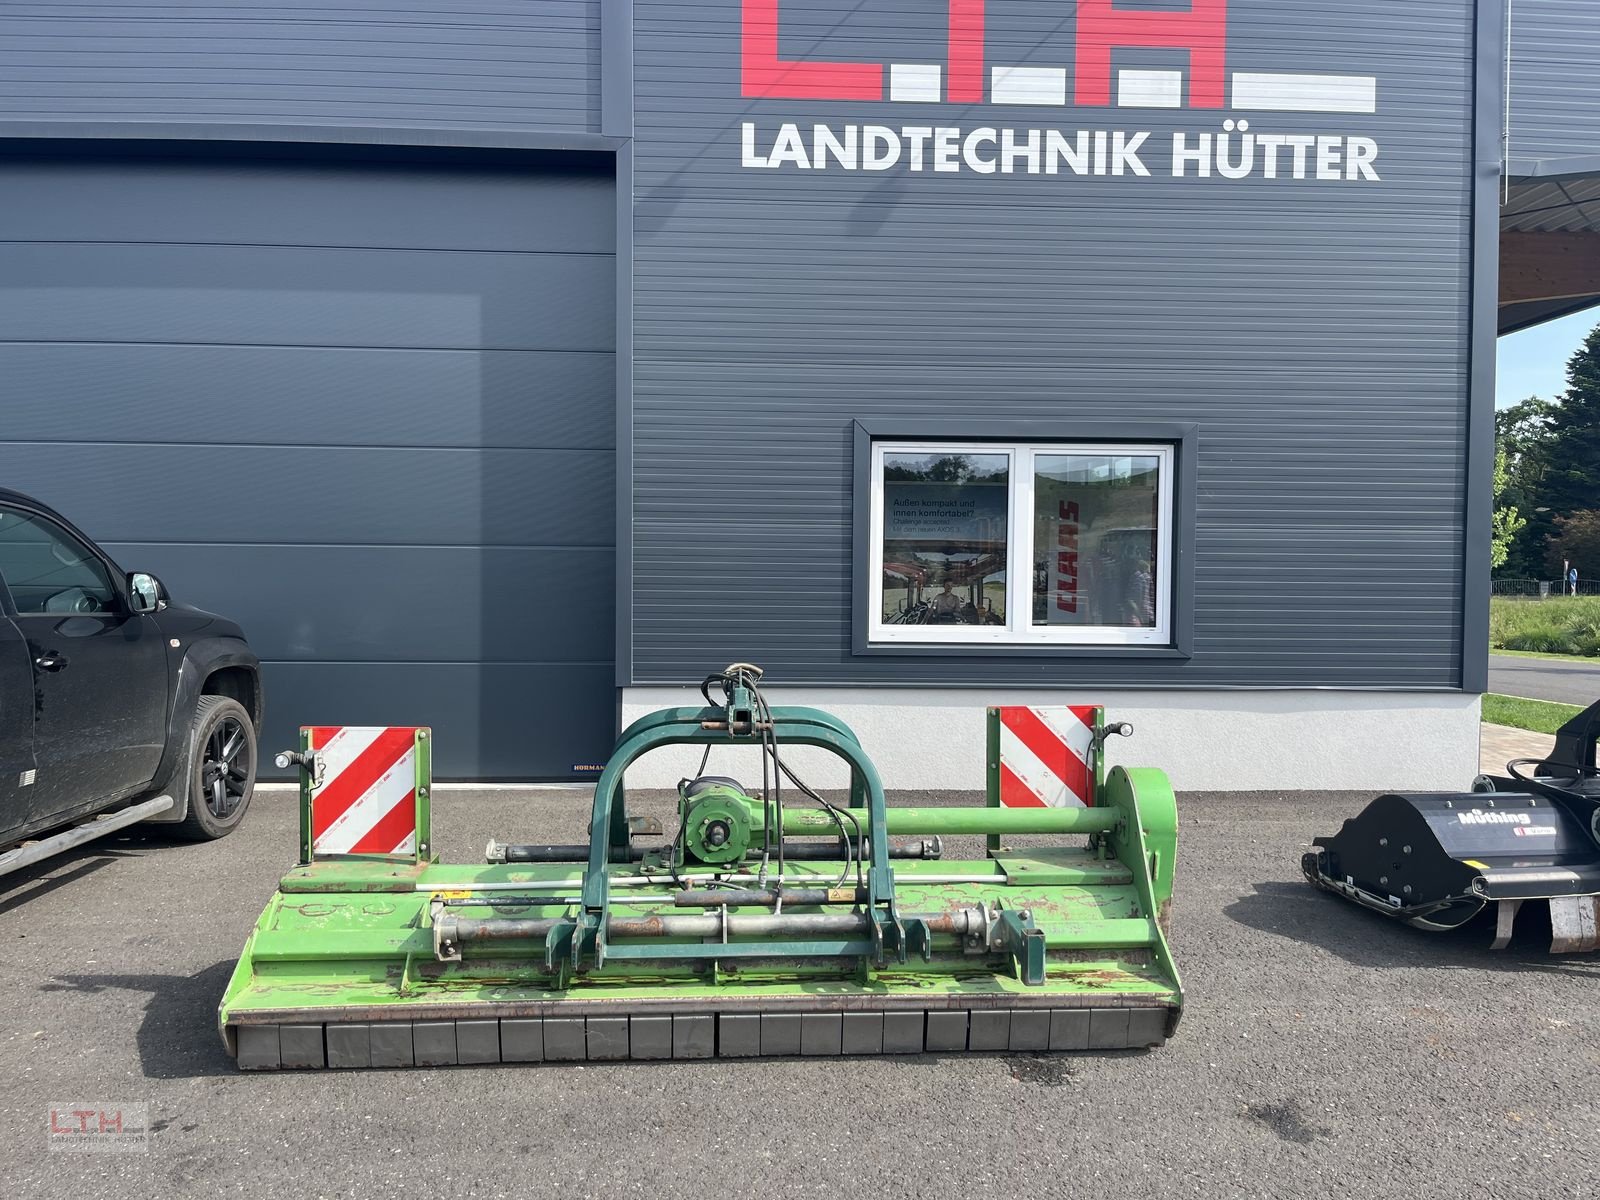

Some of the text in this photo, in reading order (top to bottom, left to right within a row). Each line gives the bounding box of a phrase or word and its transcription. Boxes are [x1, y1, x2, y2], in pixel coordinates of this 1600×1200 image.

[742, 119, 1381, 182] LANDTECHNIK HÜTTER
[893, 499, 975, 509] Außen kompakt und
[919, 510, 975, 518] komfortabel?
[1057, 500, 1079, 613] CLAAS
[1457, 808, 1531, 825] Müthing
